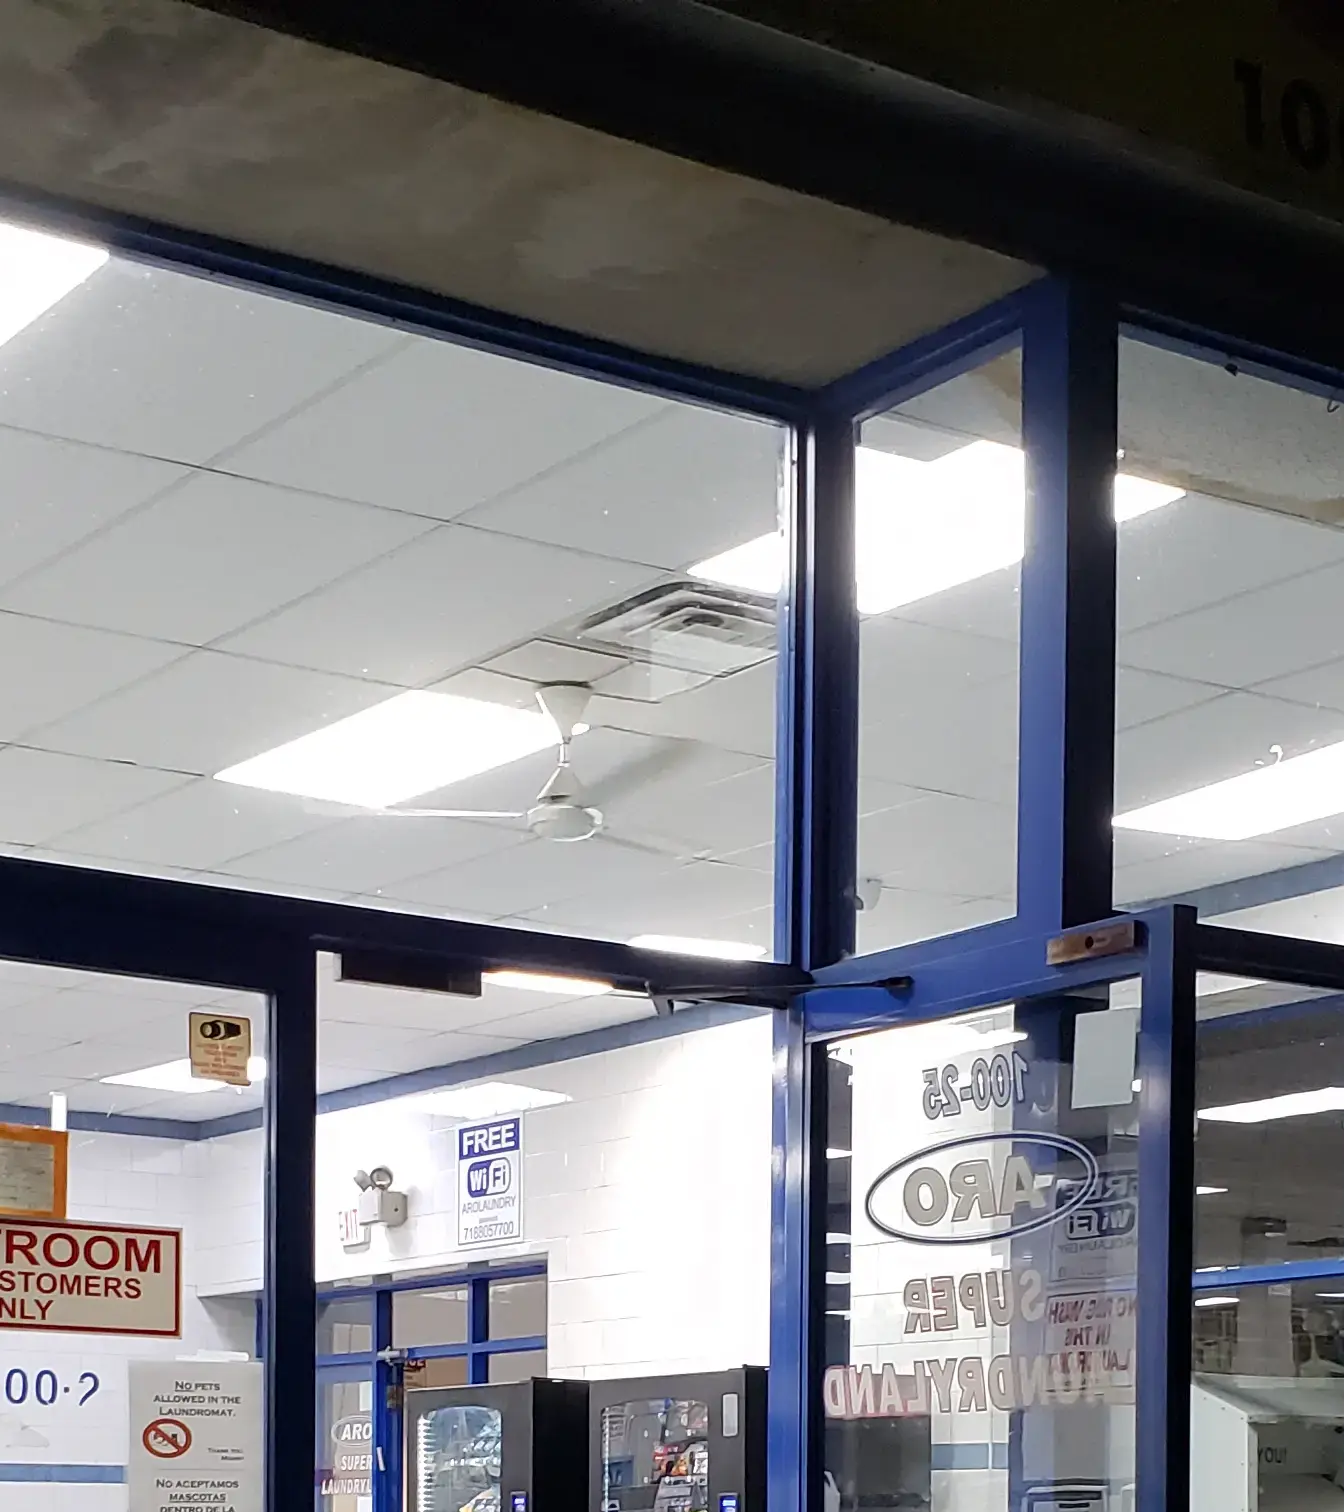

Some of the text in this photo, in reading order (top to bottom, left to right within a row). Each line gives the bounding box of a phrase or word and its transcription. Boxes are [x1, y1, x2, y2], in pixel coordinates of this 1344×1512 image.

[462, 1123, 515, 1156] FREE
[462, 1196, 516, 1214] AROLAUNDRY
[154, 1395, 205, 1403] ALLOWED
[221, 1396, 241, 1404] THE
[340, 1422, 372, 1441] ARO
[176, 1480, 239, 1489] ACEPTAMOS
[321, 1478, 372, 1495] LAUNDRYL
[169, 1493, 226, 1502] MASCOTAS
